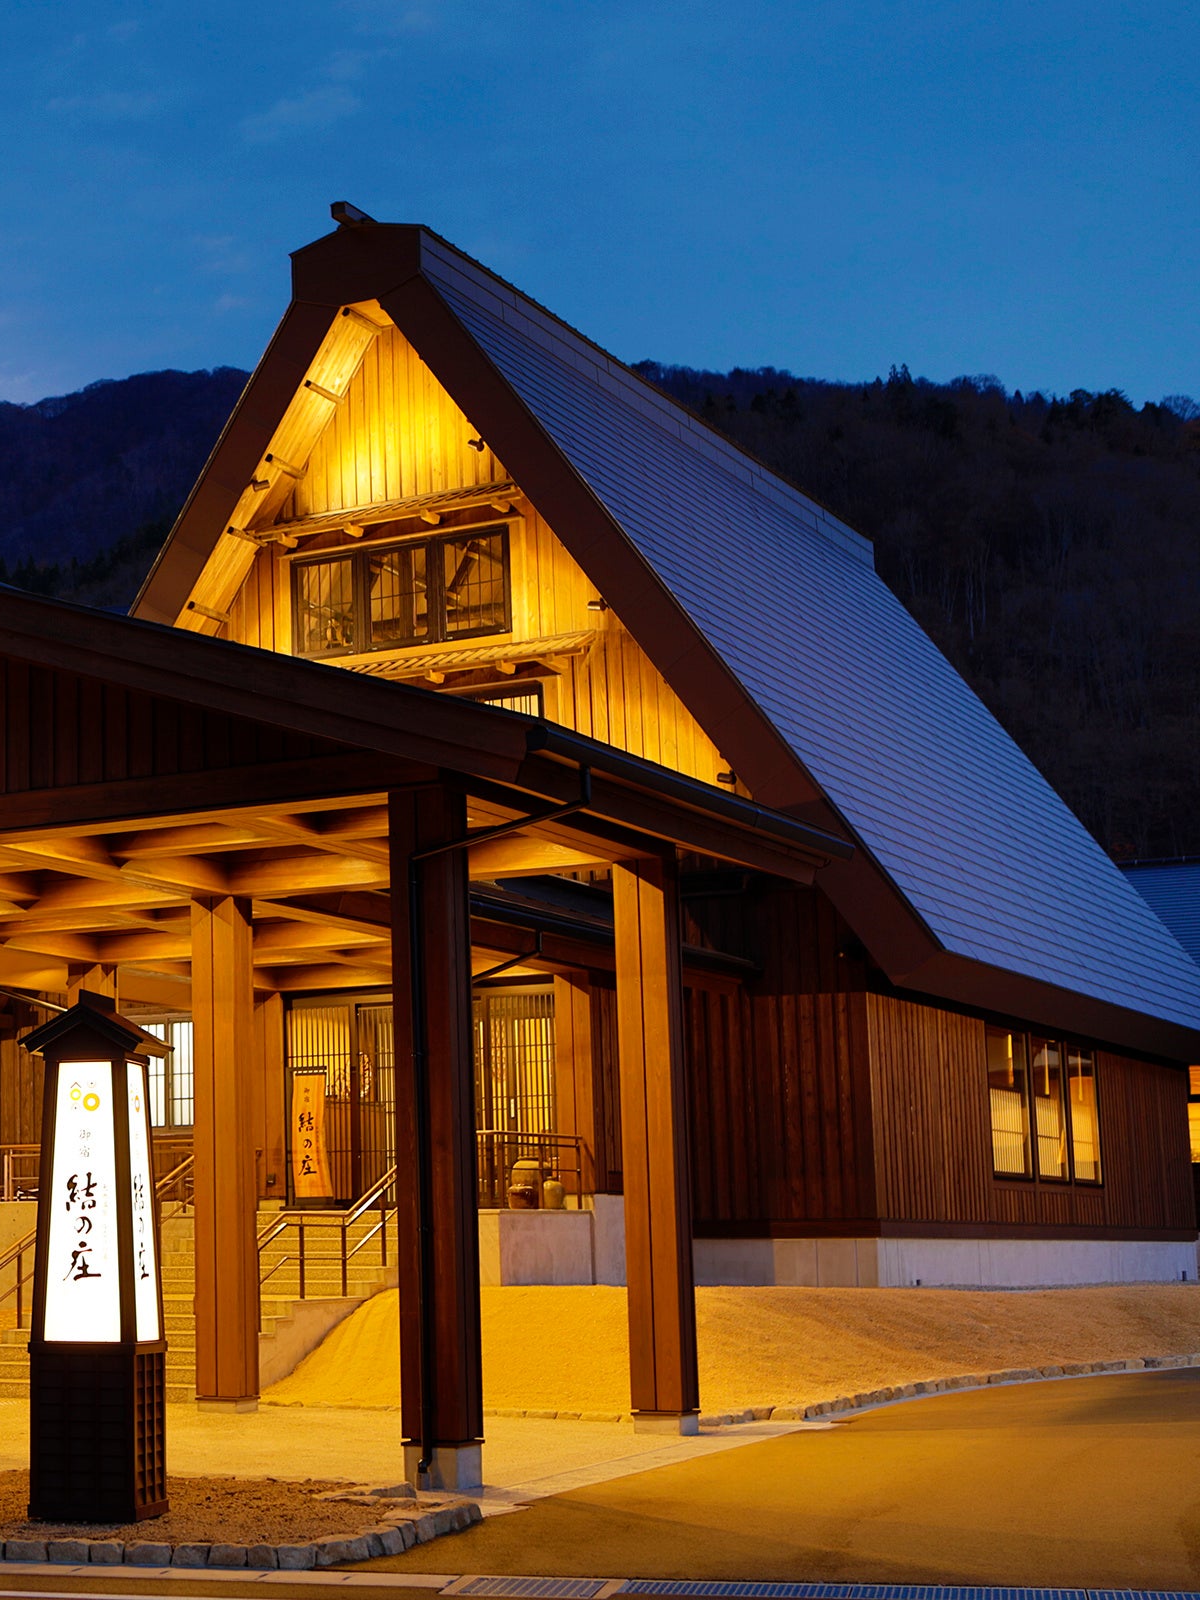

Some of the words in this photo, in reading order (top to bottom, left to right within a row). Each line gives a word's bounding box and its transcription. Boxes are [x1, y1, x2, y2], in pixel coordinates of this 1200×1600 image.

[299, 1112, 317, 1176] 結の庄
[63, 1171, 102, 1281] 結の庄
